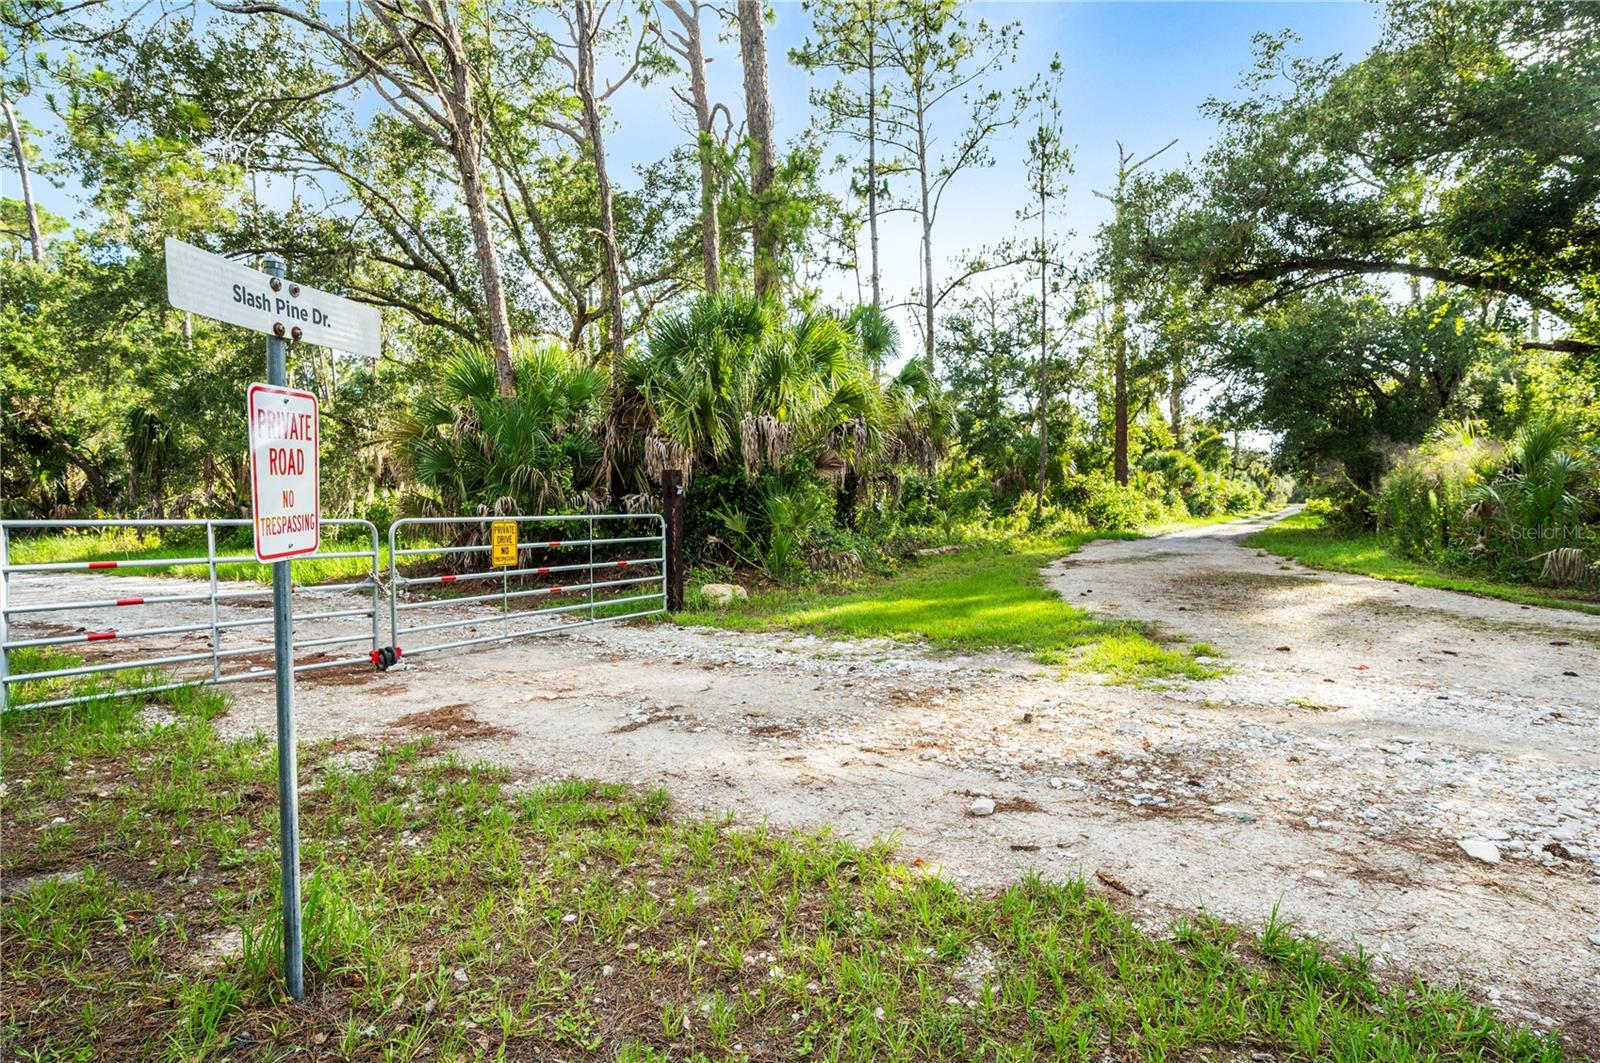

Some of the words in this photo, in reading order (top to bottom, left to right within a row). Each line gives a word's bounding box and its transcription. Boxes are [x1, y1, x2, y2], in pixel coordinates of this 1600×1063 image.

[233, 284, 271, 312] Slash
[276, 298, 308, 321] Pine
[312, 308, 331, 328] Dr.
[258, 409, 312, 441] PRIVATE
[269, 448, 304, 475] ROAD
[283, 490, 294, 507] NO
[261, 513, 314, 536] TRESPASSING
[494, 525, 515, 534] PRIVATE
[497, 535, 512, 544] DRIVE
[501, 547, 509, 555] NO
